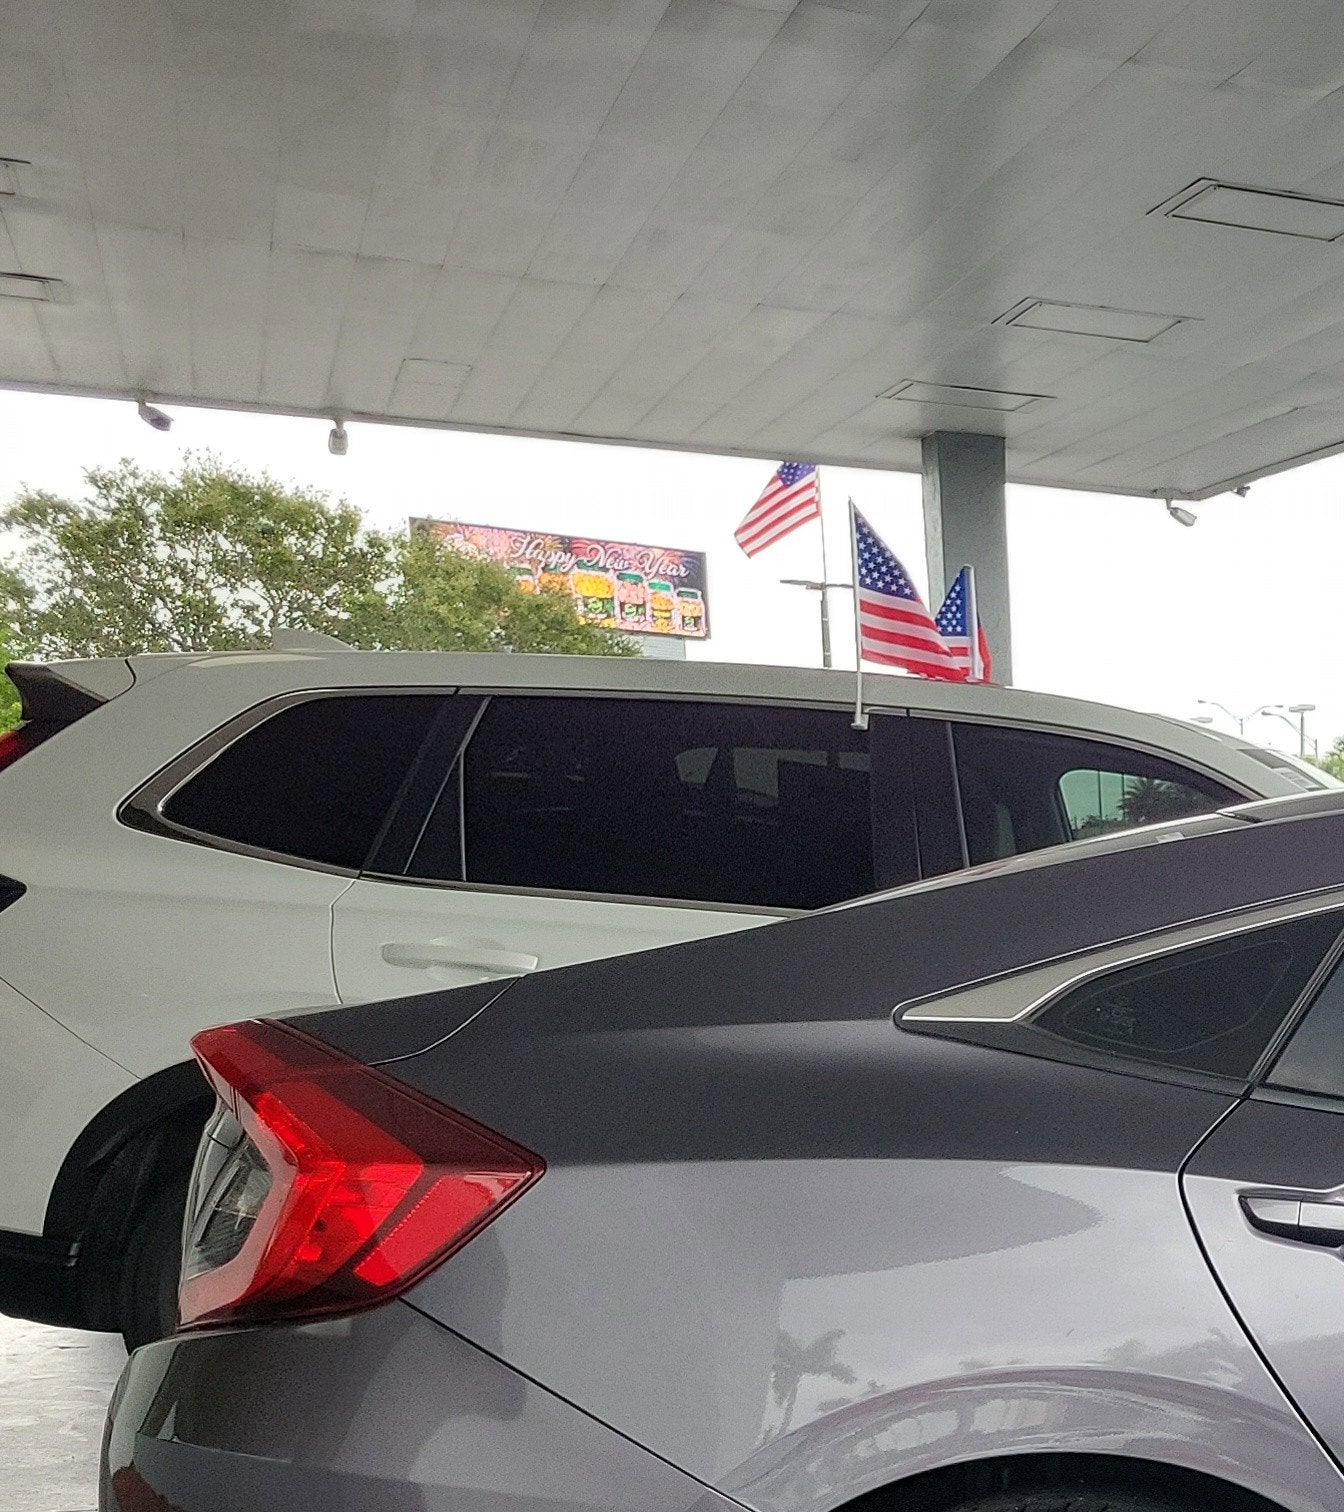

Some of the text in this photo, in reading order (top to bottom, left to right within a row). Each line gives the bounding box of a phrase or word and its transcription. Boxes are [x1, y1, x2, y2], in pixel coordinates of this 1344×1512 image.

[507, 535, 691, 578] Happy New Year
